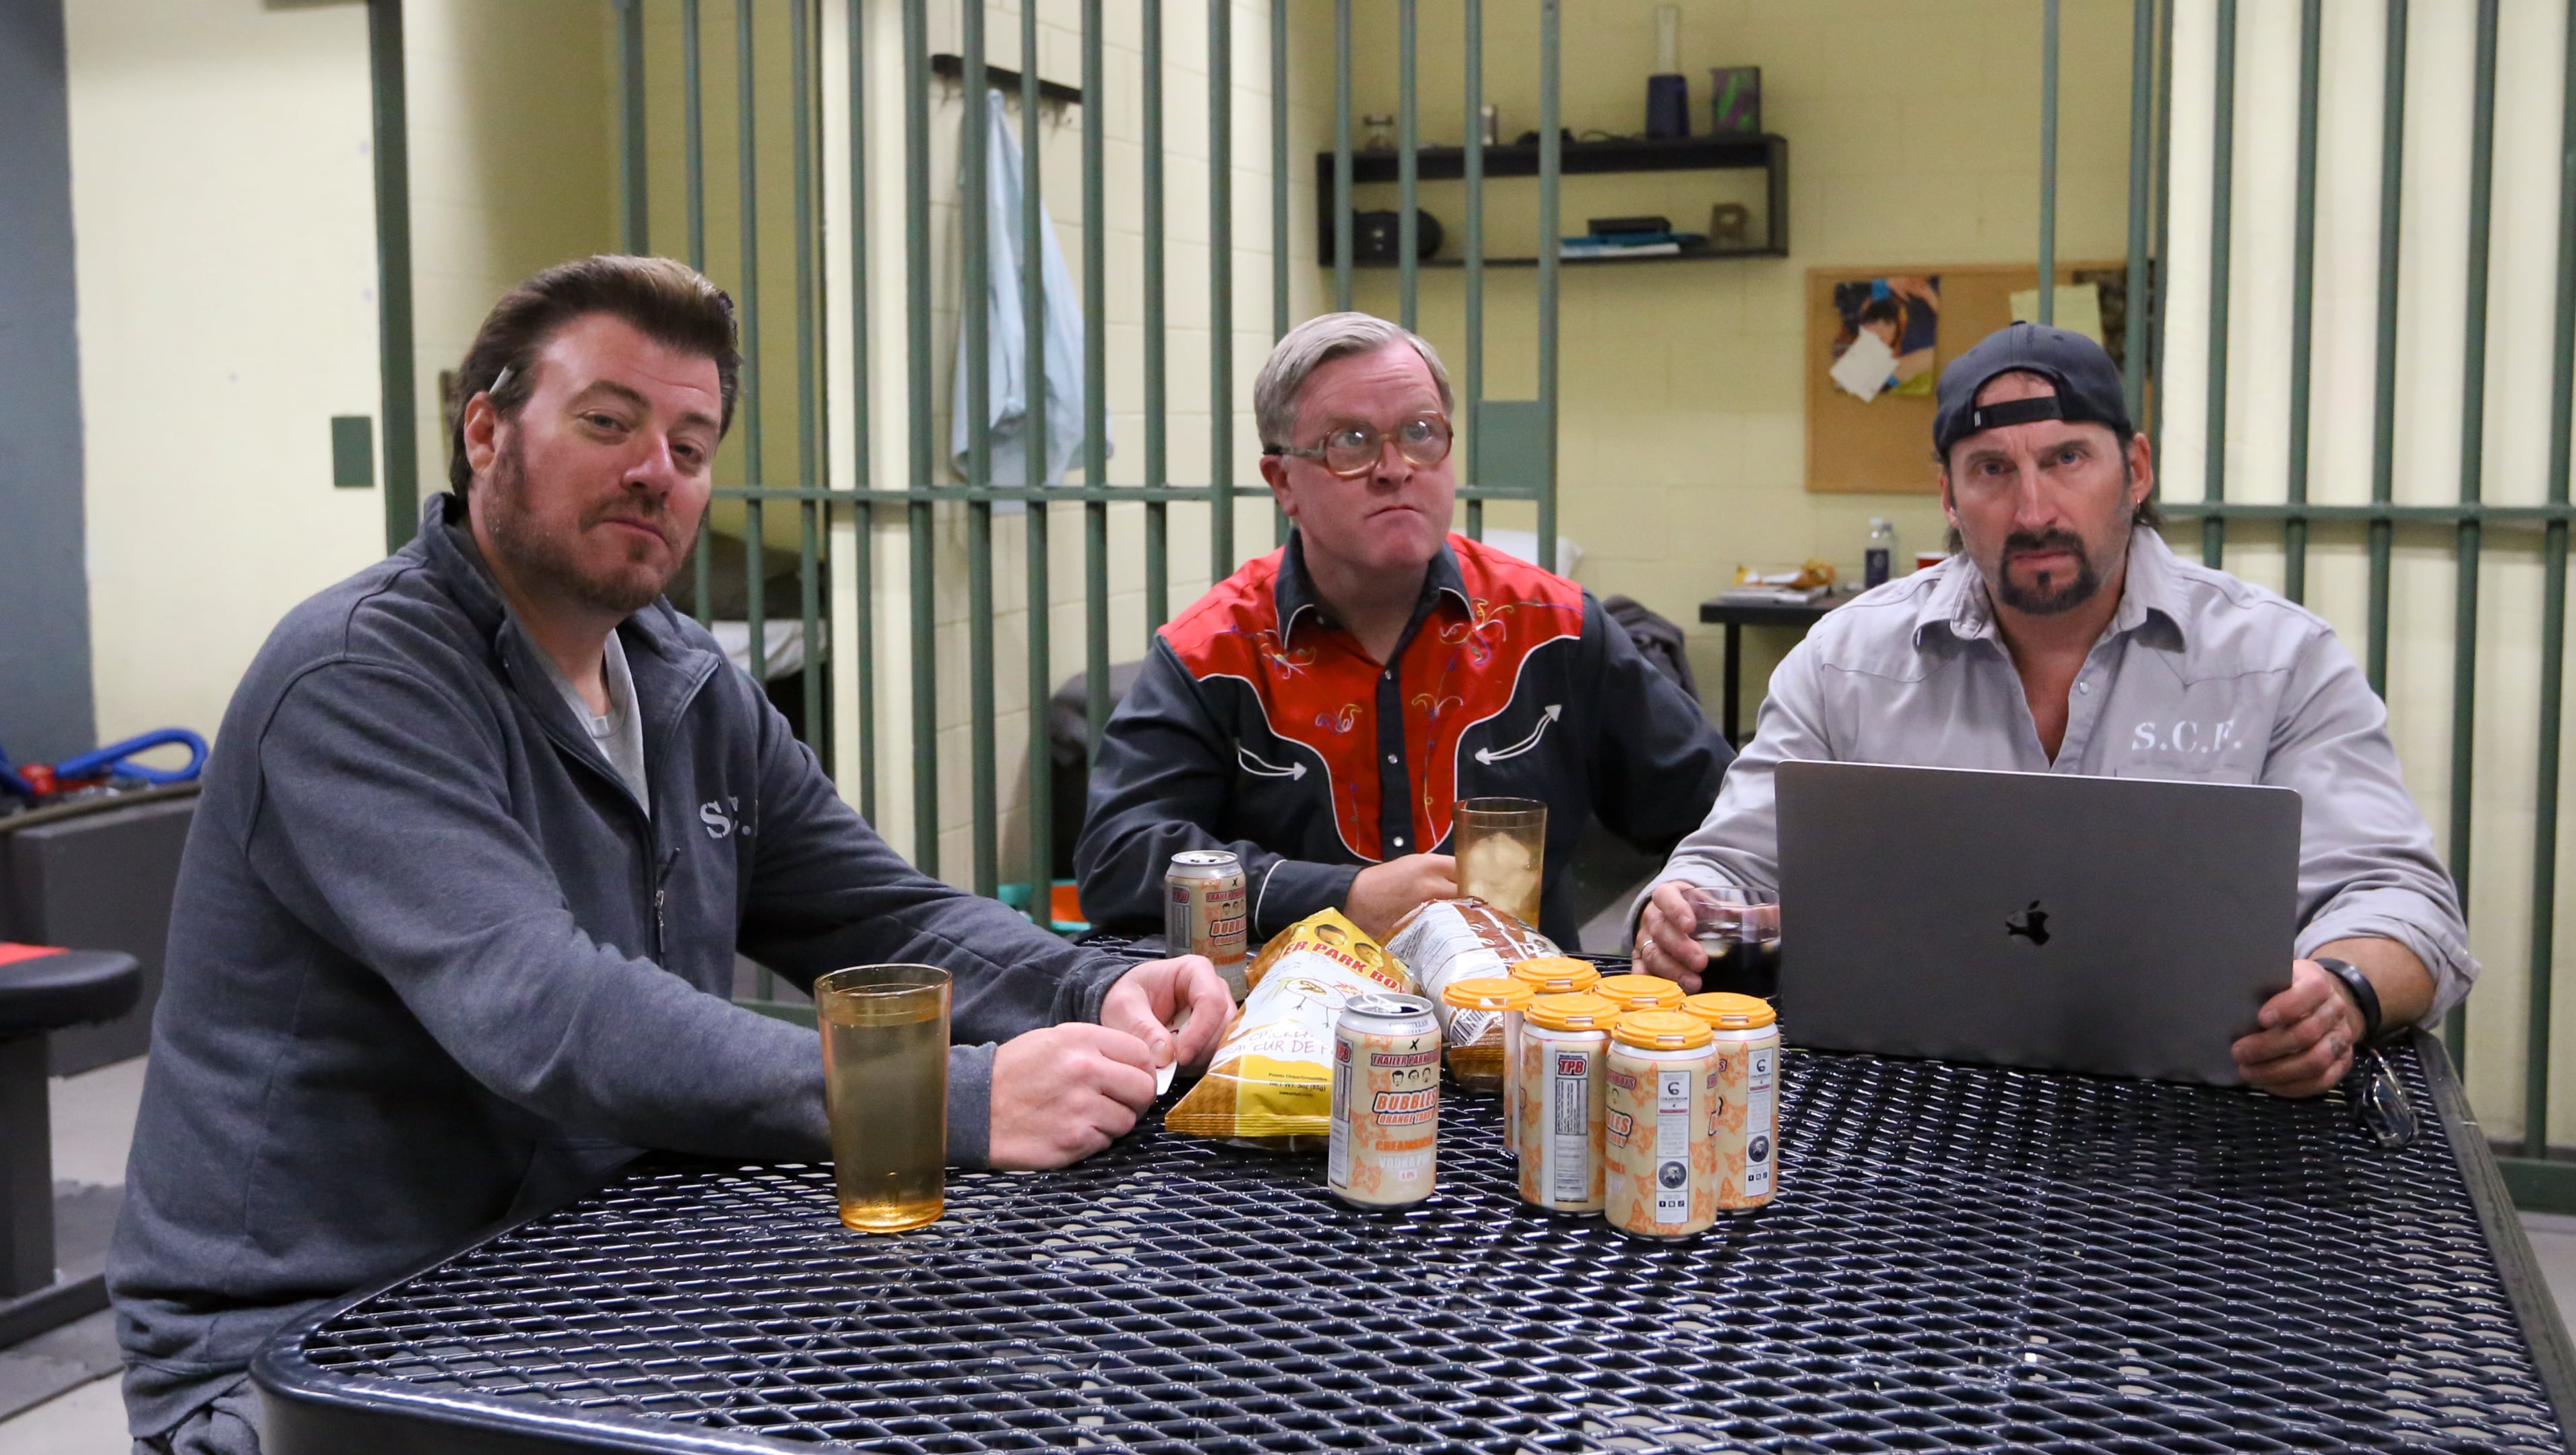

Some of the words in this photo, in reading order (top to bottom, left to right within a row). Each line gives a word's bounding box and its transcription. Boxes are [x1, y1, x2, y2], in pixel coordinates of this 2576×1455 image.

[1312, 942, 1367, 973] PARK
[1291, 1039, 1315, 1054] DE
[1409, 1038, 1419, 1051] X
[1372, 1054, 1407, 1066] TRAILER
[1559, 1059, 1586, 1074] TPB
[1375, 1088, 1437, 1111] BUBBLES
[1379, 1113, 1413, 1124] ORANGE
[1379, 1156, 1415, 1168] VODKA
